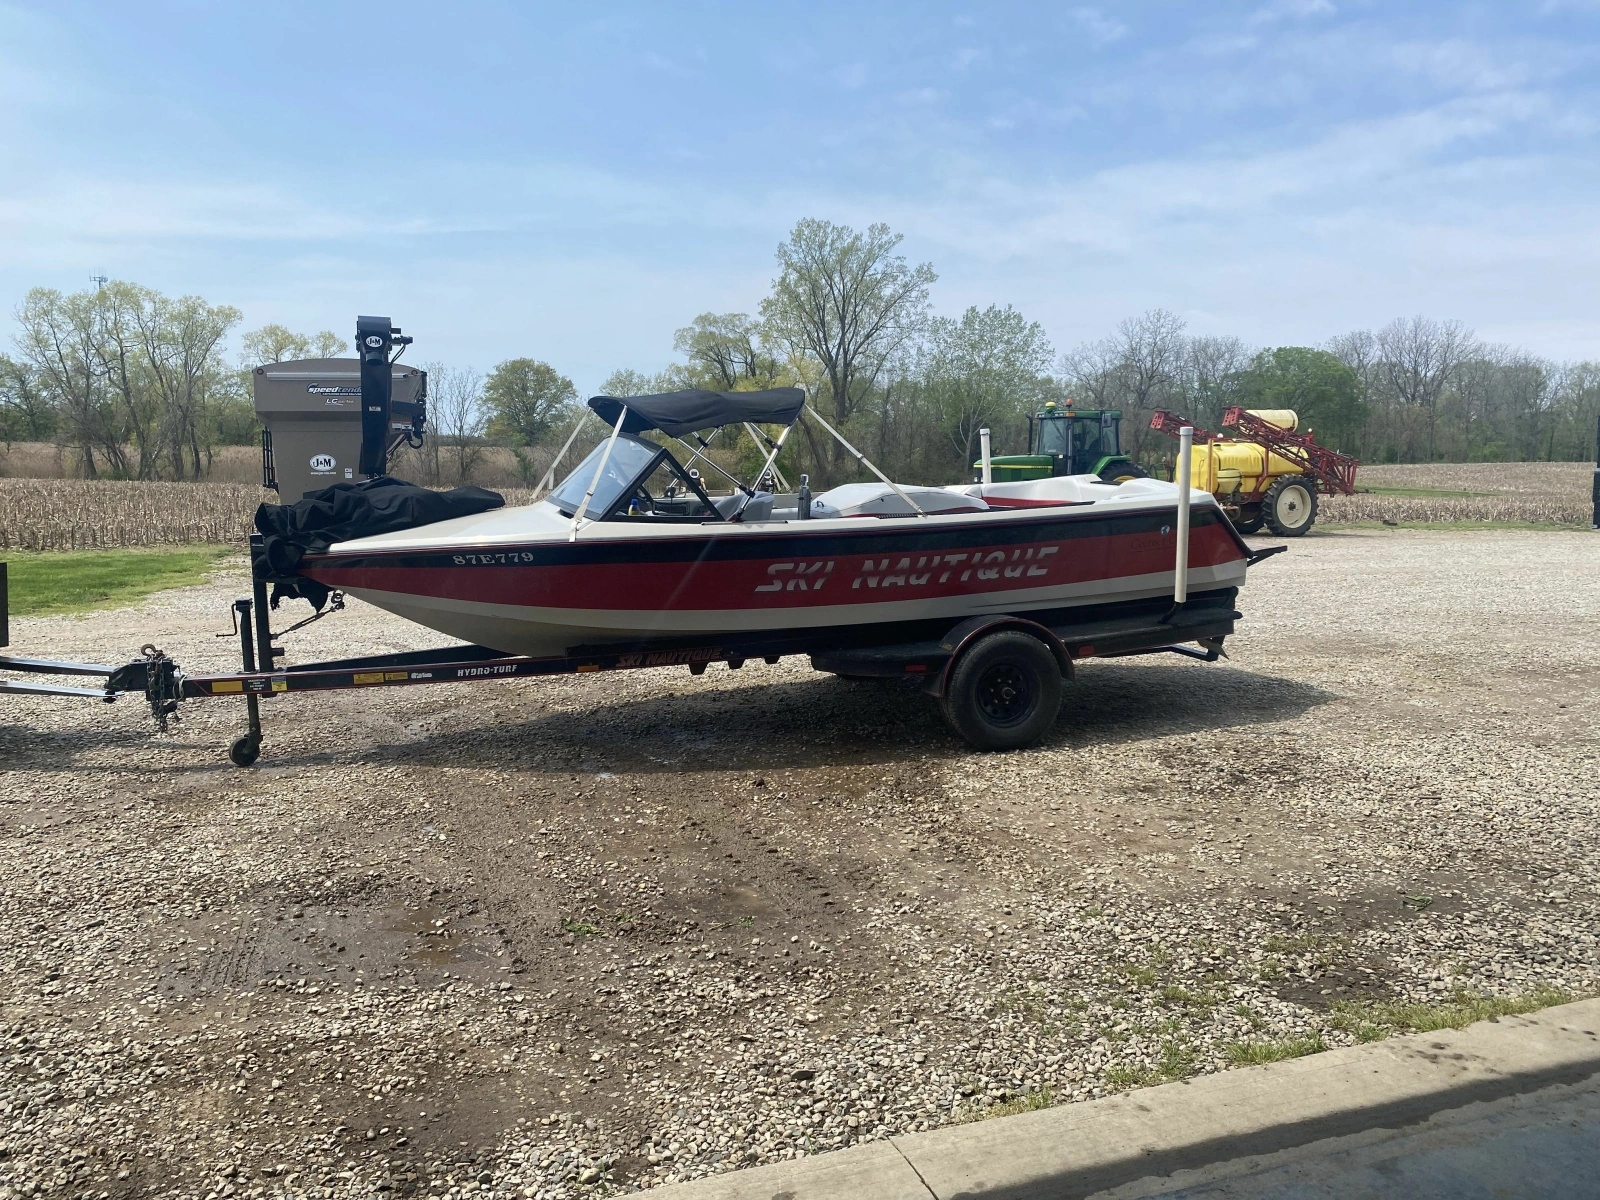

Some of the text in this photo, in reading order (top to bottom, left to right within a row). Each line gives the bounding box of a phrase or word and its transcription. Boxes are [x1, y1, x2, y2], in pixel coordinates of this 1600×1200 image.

[307, 385, 361, 394] speedtend
[312, 458, 332, 467] J&M
[452, 551, 534, 565] 87E779
[754, 546, 1060, 592] SKI NAUTIQUE
[615, 648, 723, 667] SKI NAUTIQUE
[457, 664, 518, 677] HYDRO-TURF
